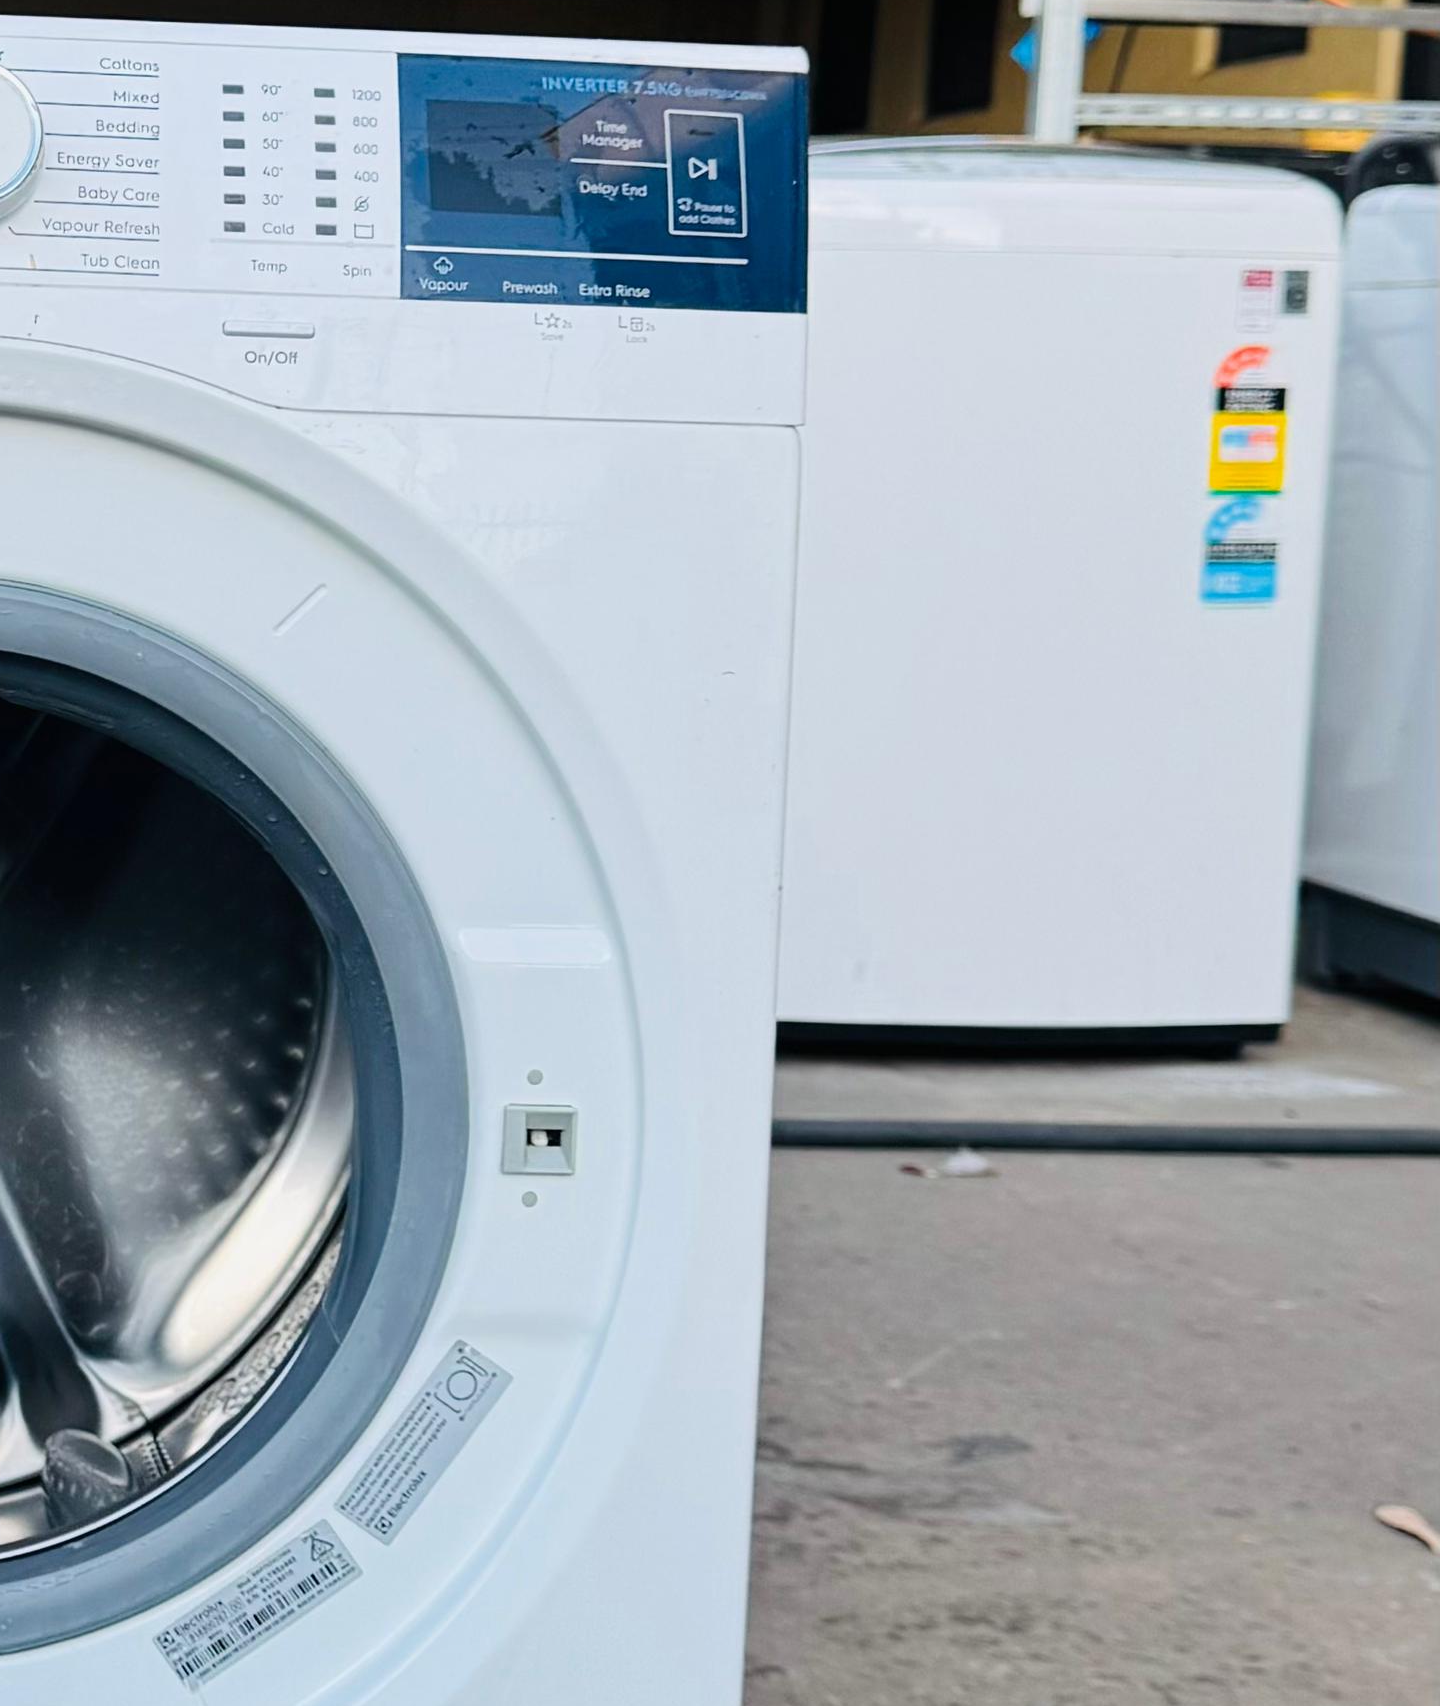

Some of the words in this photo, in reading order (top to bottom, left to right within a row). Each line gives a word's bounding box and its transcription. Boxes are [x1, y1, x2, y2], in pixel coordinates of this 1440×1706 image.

[99, 57, 160, 73] Cottons
[351, 88, 382, 102] 1200
[541, 76, 627, 94] INVERTER
[633, 80, 682, 97] 7.5KG
[113, 89, 160, 105] Mixed
[95, 118, 161, 137] Bedding
[352, 115, 378, 128] 800
[596, 119, 628, 134] Time
[352, 143, 379, 156] 600
[581, 133, 644, 151] Manager
[56, 151, 110, 170] Energy
[114, 154, 160, 169] Saver
[353, 170, 379, 183] 400
[77, 185, 119, 204] Baby
[122, 187, 161, 203] Care
[578, 180, 620, 197] Delay
[621, 183, 648, 197] End
[41, 217, 100, 235] Vapour
[104, 219, 161, 237] Refresh
[261, 222, 295, 236] Cold
[80, 253, 110, 269] Tub
[113, 254, 161, 270] Clean
[251, 259, 288, 274] Temp
[342, 264, 373, 278] Spin
[419, 277, 470, 294] Vapour
[502, 280, 558, 296] Prewash
[579, 282, 613, 298] Extra
[615, 284, 652, 299] Rinse
[244, 350, 298, 367] On/Off
[385, 1467, 427, 1519] Electrolux
